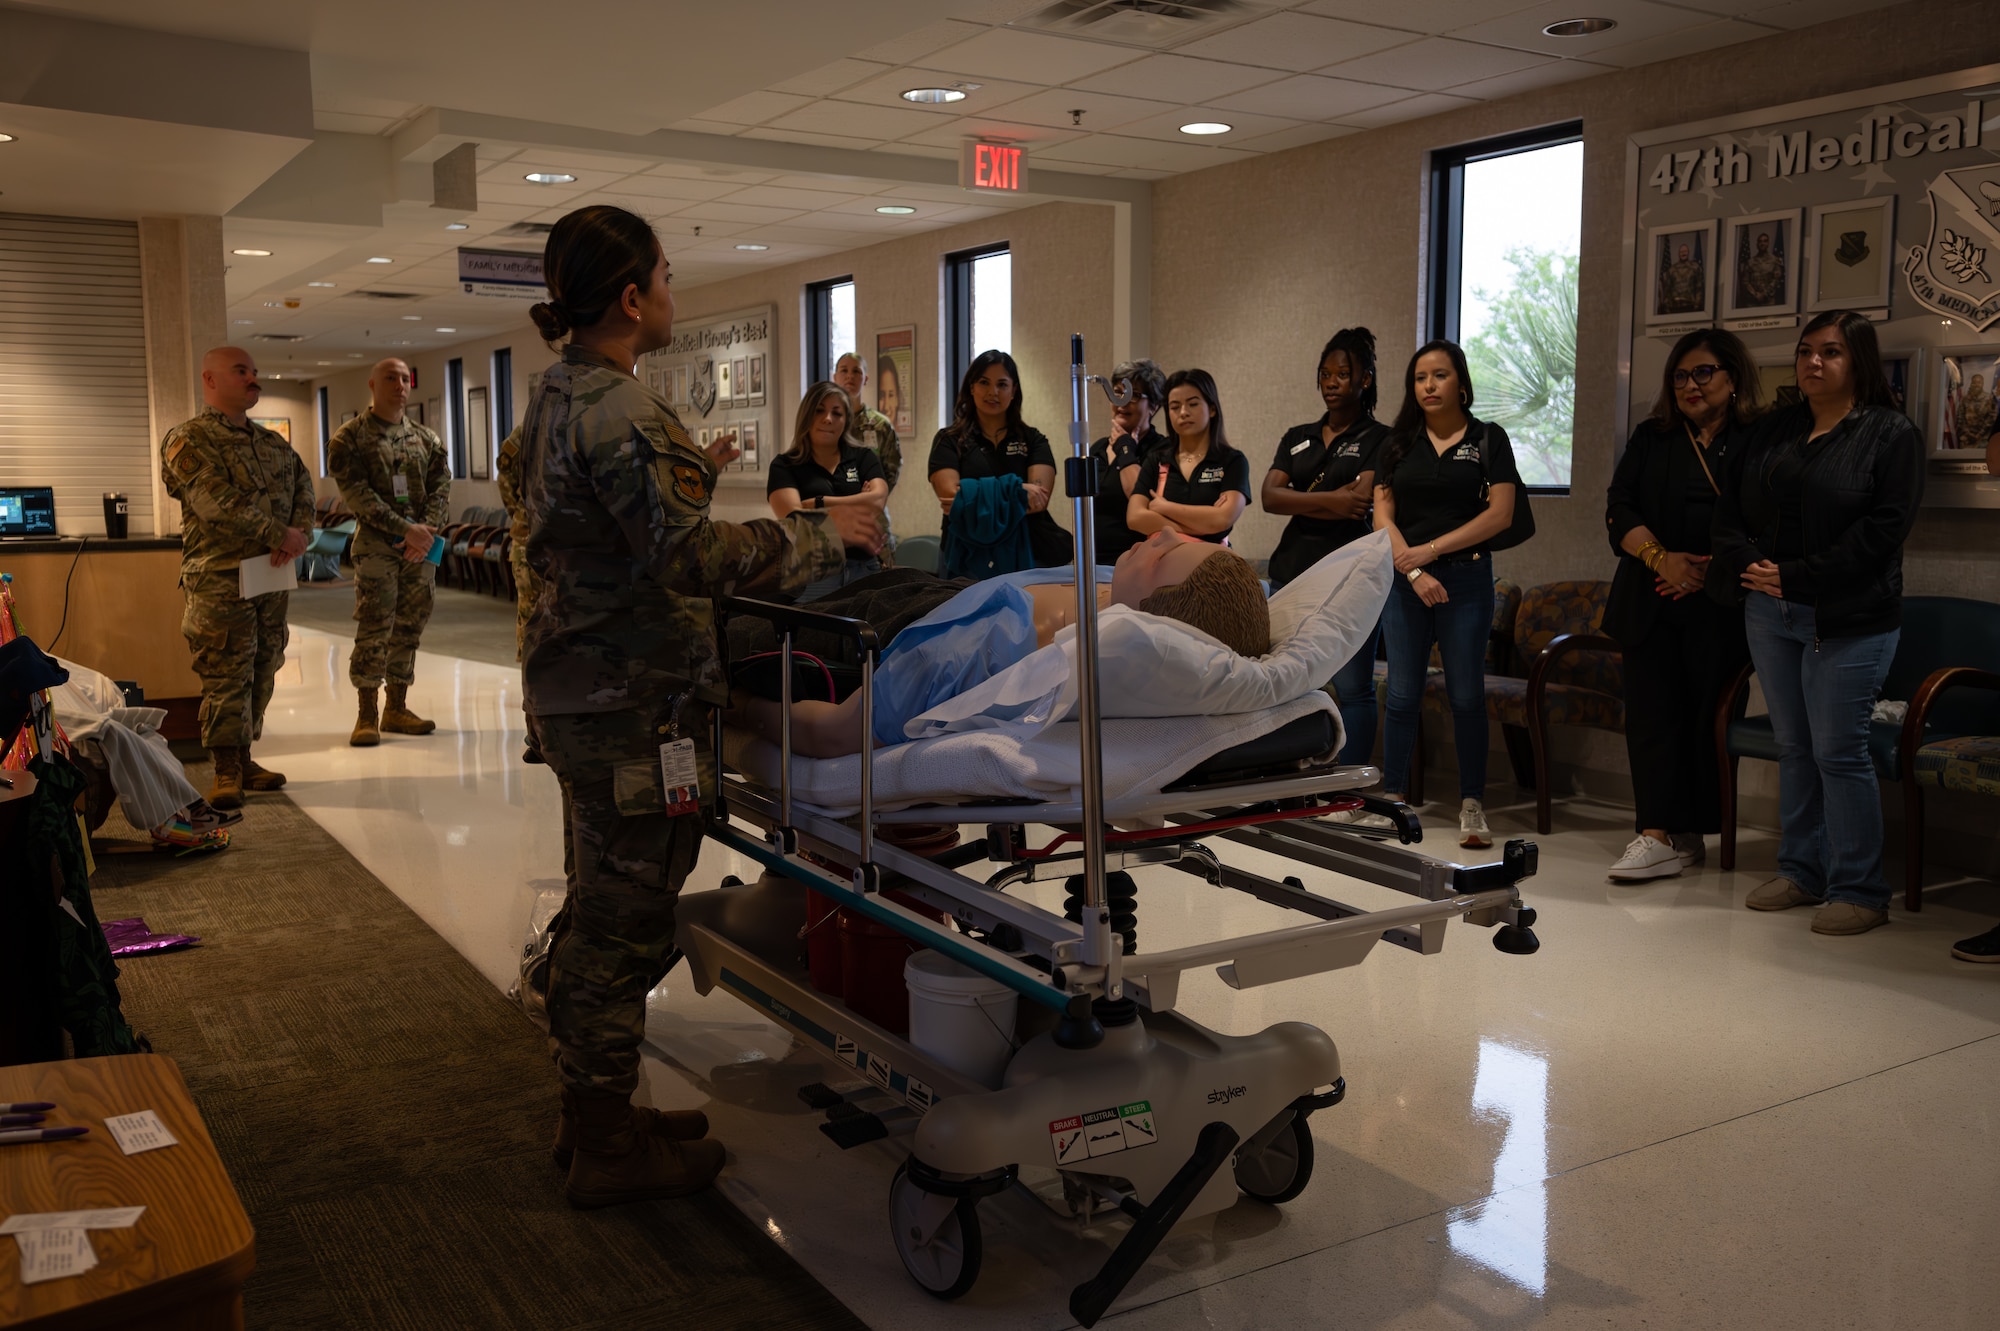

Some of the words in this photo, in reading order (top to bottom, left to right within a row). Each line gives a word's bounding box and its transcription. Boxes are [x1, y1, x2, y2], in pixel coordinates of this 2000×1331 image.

[1649, 143, 1750, 194] 47th
[1767, 100, 1983, 178] Medical
[975, 144, 1022, 191] EXIT
[468, 260, 501, 272] FAMILY
[503, 263, 544, 274] MEDICIN
[1914, 275, 1934, 300] 47th
[704, 324, 740, 351] Group's
[743, 319, 768, 345] Best
[1207, 1085, 1247, 1105] stryker
[1053, 1118, 1078, 1131] BRAKE
[1084, 1110, 1117, 1124] NEUTRAL
[1124, 1103, 1147, 1115] STEER
